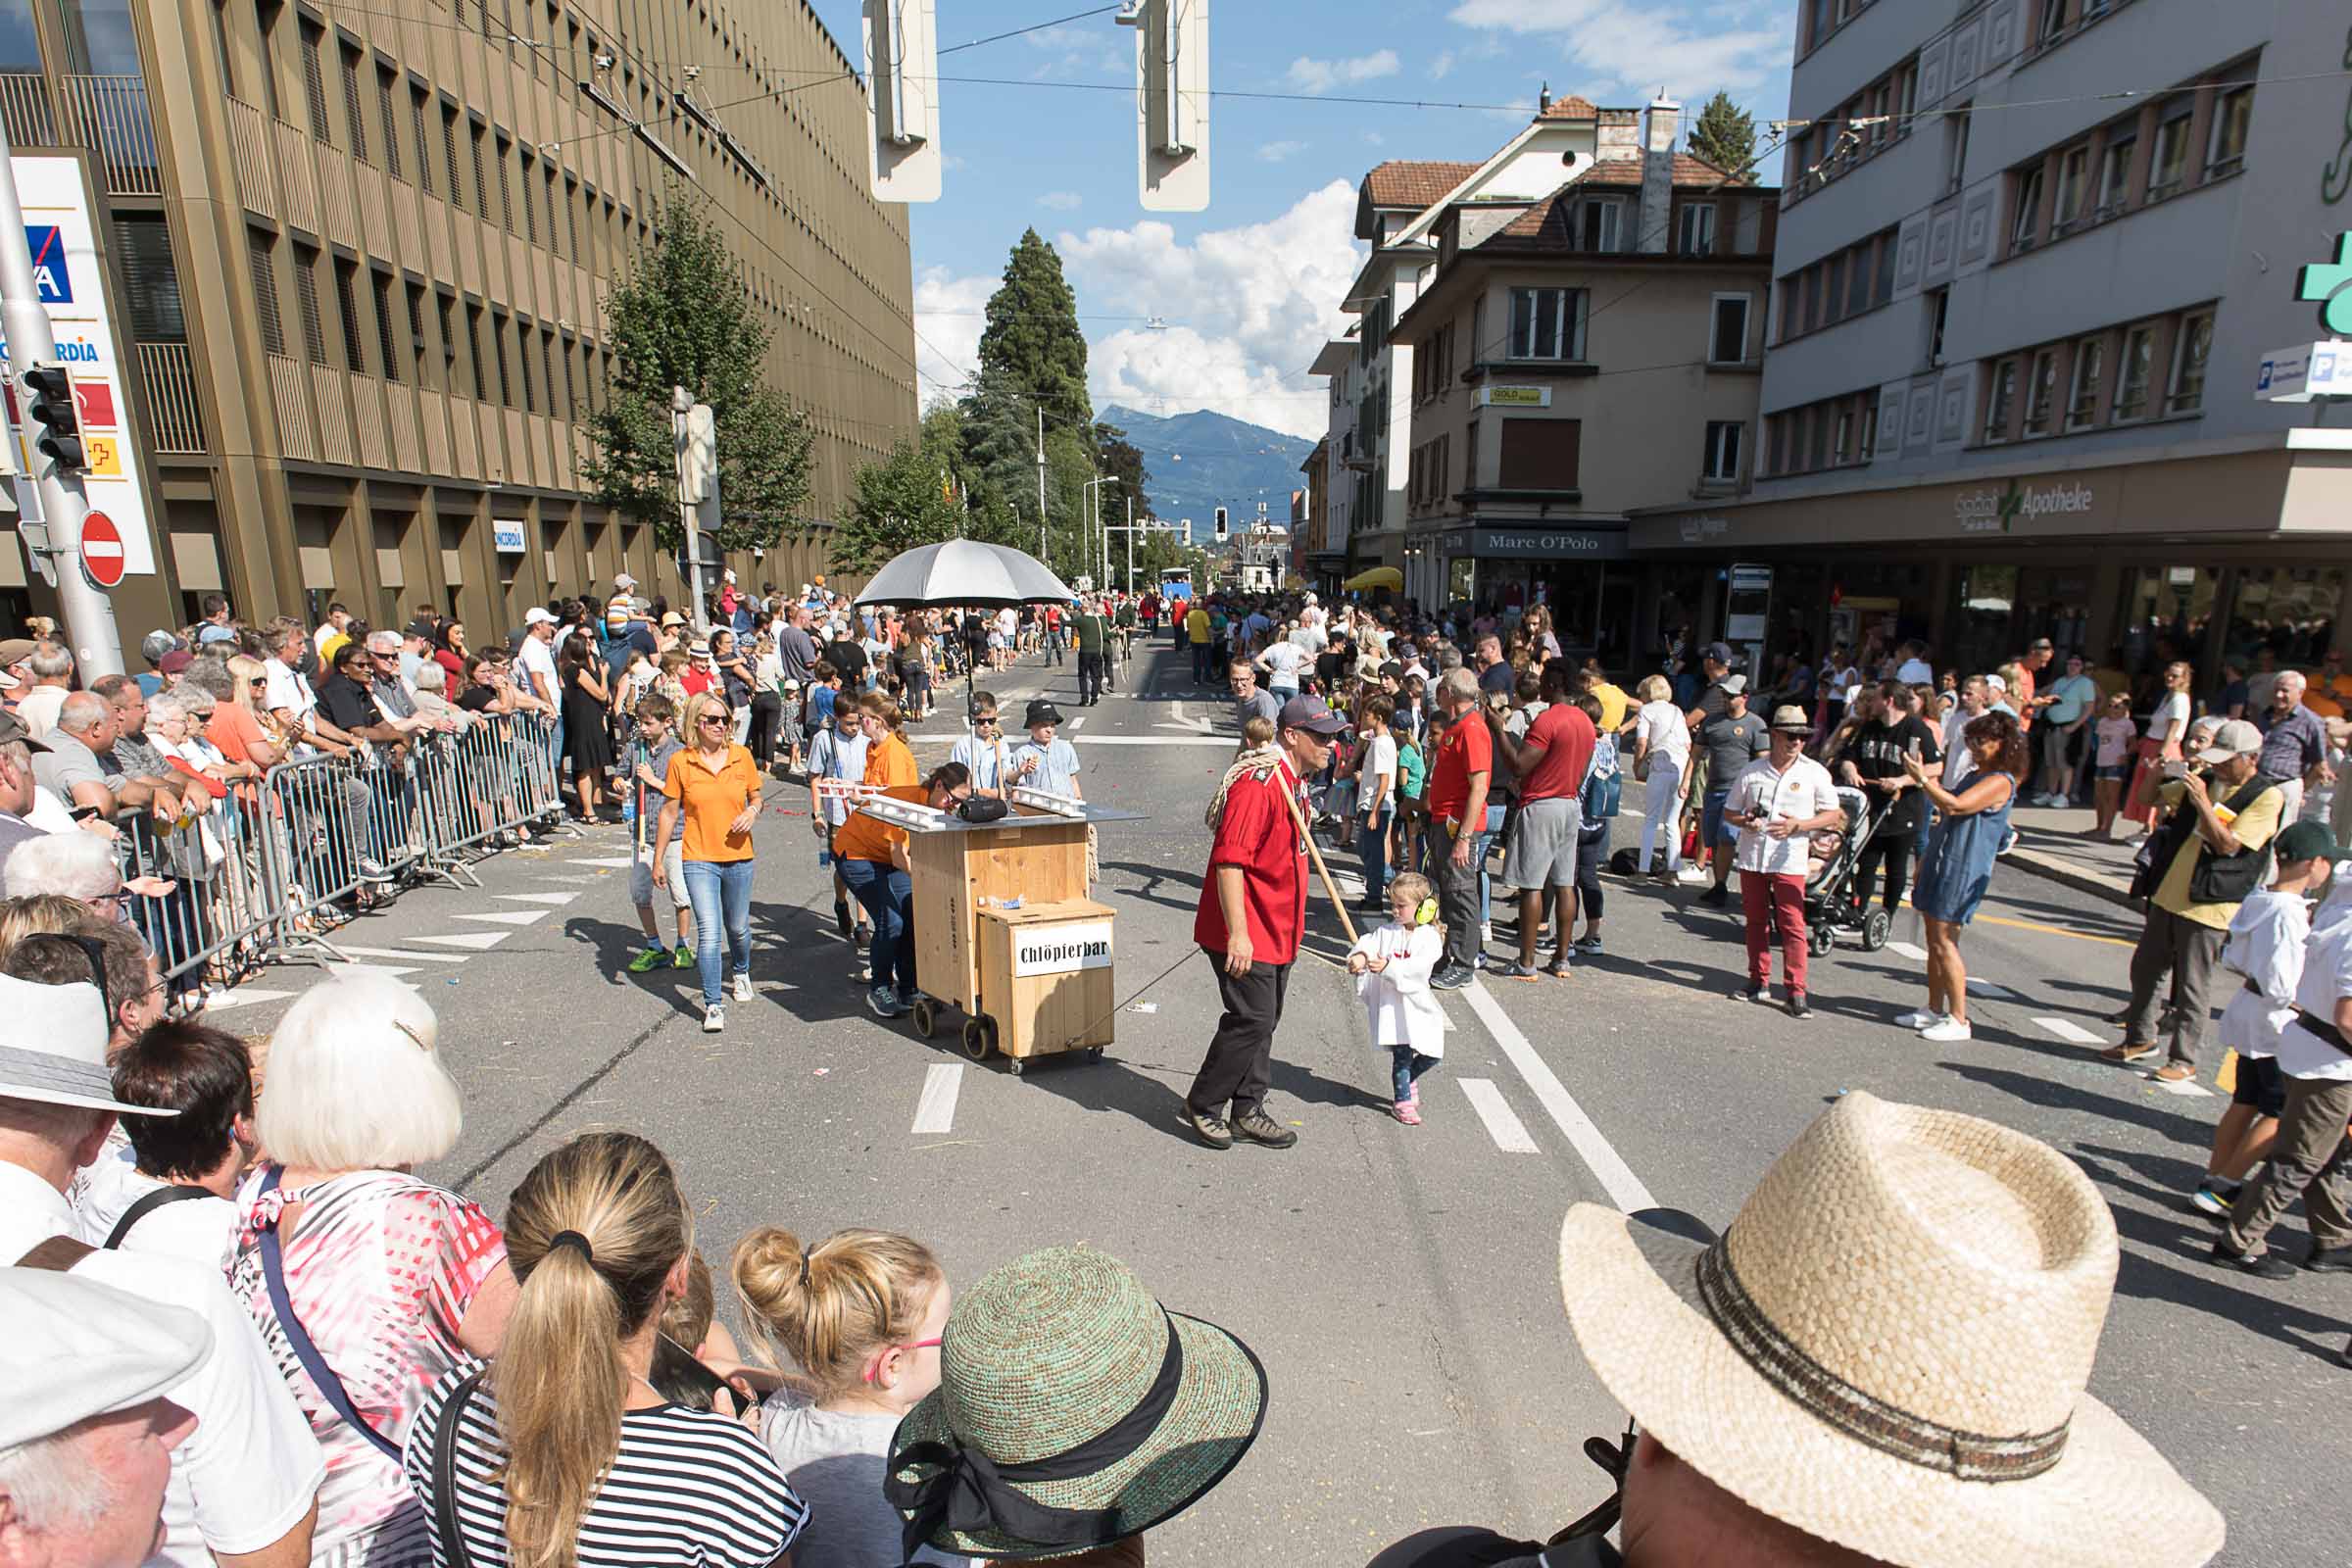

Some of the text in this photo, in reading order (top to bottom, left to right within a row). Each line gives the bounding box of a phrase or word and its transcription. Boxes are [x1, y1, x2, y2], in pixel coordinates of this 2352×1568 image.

[2021, 481, 2093, 519] Apotheke
[1489, 534, 1599, 550] Marc O'Polo
[1020, 940, 1108, 964] Chlöpferbar
